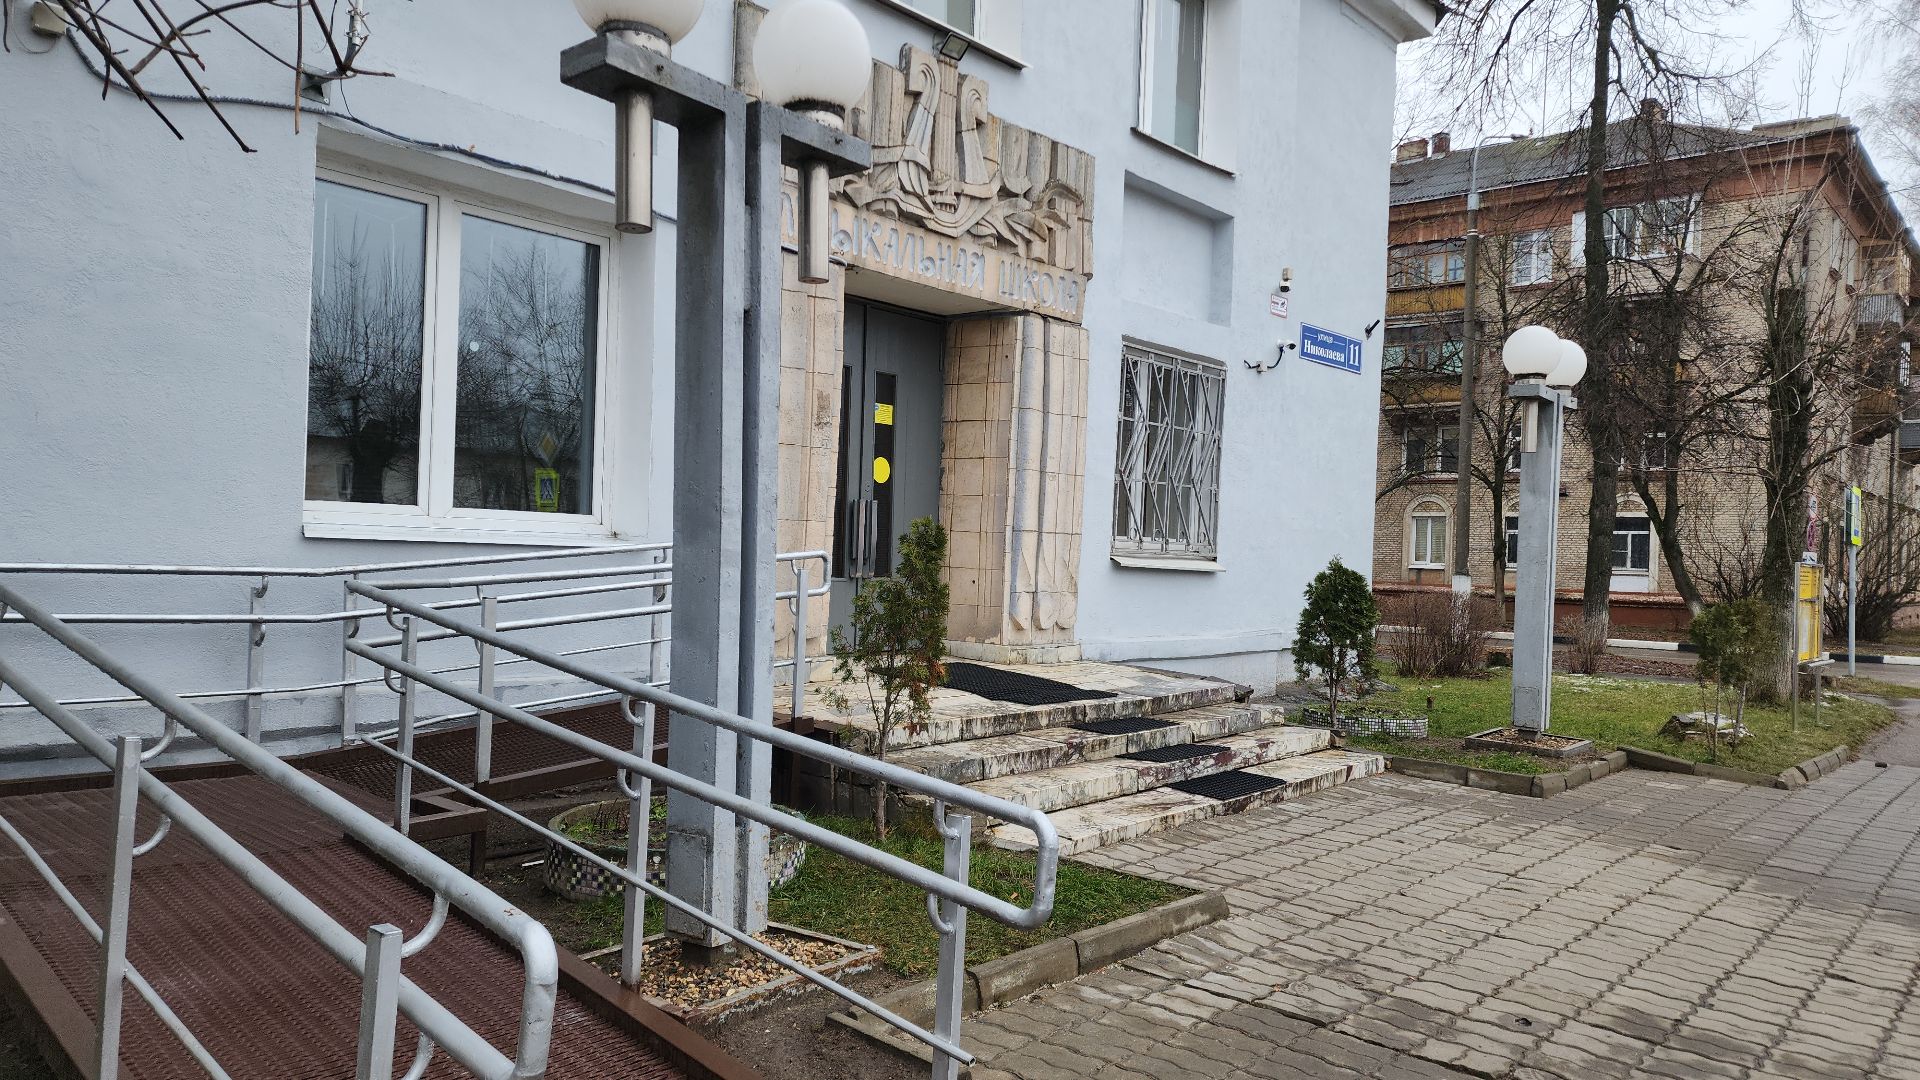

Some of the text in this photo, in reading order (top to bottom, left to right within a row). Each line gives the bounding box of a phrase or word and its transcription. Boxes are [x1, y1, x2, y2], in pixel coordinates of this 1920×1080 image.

[999, 260, 1078, 315] ШКОЛА
[1317, 333, 1334, 344] улица
[1304, 339, 1360, 367] Николаева 11
